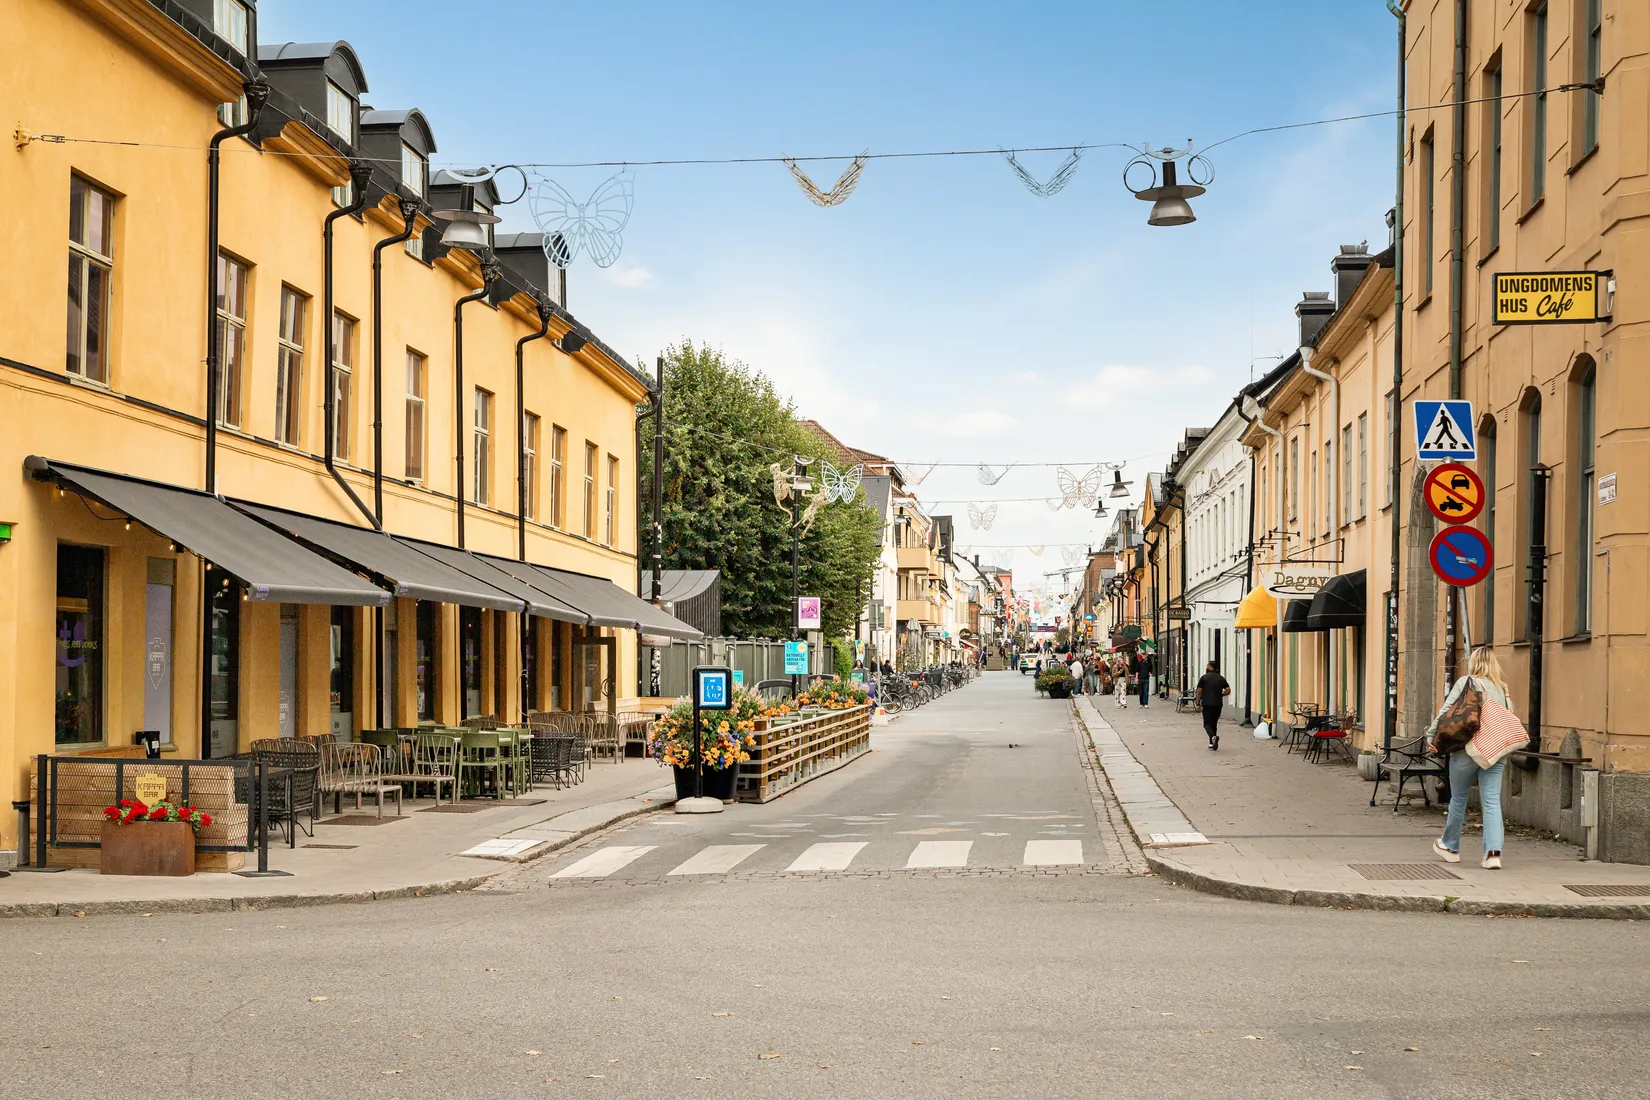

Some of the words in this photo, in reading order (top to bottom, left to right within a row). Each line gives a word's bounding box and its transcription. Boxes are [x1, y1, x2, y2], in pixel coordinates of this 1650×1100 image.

[1500, 276, 1592, 293] UNGDOMENS
[1500, 298, 1528, 313] HUS
[1536, 292, 1575, 318] Café
[1273, 572, 1331, 591] Dagny
[150, 651, 164, 661] KAPPA
[152, 663, 161, 671] BAR
[137, 782, 165, 790] KAPPA
